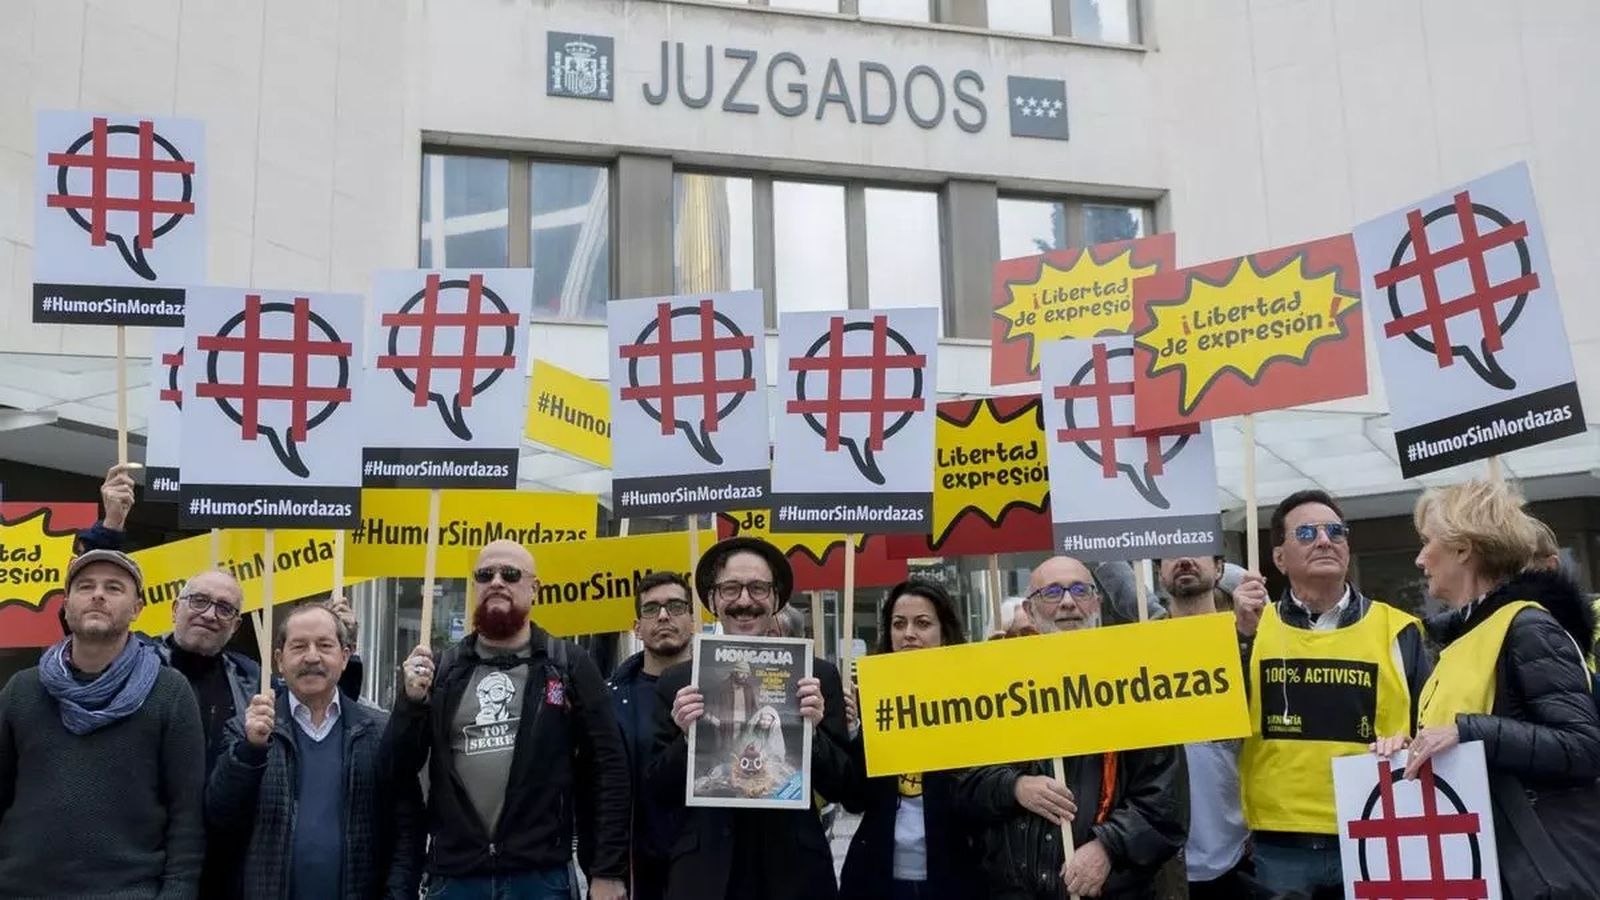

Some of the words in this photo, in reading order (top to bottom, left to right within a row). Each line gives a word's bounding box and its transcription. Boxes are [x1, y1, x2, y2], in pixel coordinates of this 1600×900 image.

[641, 41, 988, 133] JUZGADOS
[1014, 310, 1037, 327] de
[1160, 337, 1189, 358] de
[1407, 403, 1573, 461] #HumorSinMordazas
[364, 460, 509, 479] #HumorSinMordazas
[621, 484, 763, 508] #HumorSinMordazas
[189, 498, 353, 518] #HumorSinMordazas
[779, 506, 924, 524] #HumorSinMordazas
[740, 512, 765, 531] de
[1064, 528, 1215, 551] #HumorSinMordazas
[1265, 668, 1301, 684] 100%
[1305, 668, 1372, 688] ACTIVISTA
[876, 665, 1229, 733] #HumorSinMordazas
[482, 724, 510, 738] TOP
